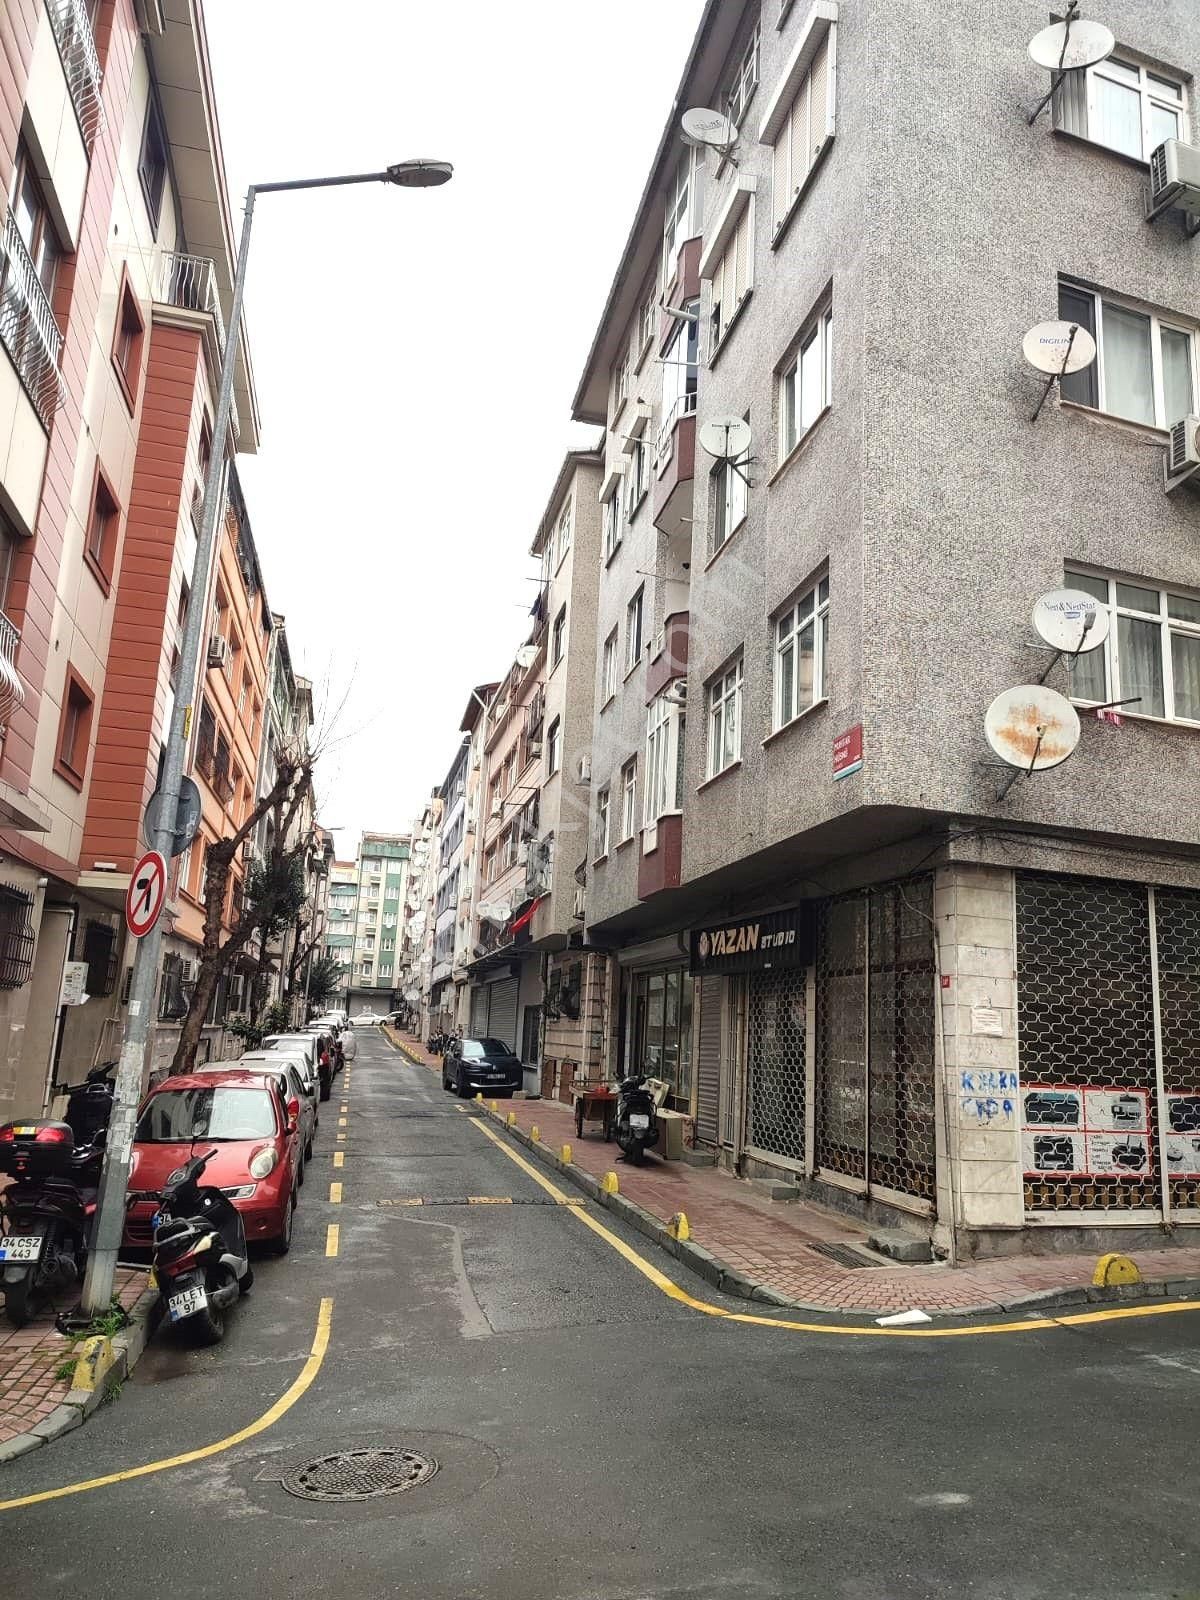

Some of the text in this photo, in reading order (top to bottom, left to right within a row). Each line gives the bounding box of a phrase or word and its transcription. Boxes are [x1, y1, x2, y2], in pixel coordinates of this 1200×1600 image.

[1039, 336, 1072, 345] DIGILIN
[710, 923, 796, 956] YAZAN STUDIO
[2, 1237, 41, 1248] 34 CSZ
[11, 1250, 31, 1259] 443
[183, 1300, 196, 1314] 97
